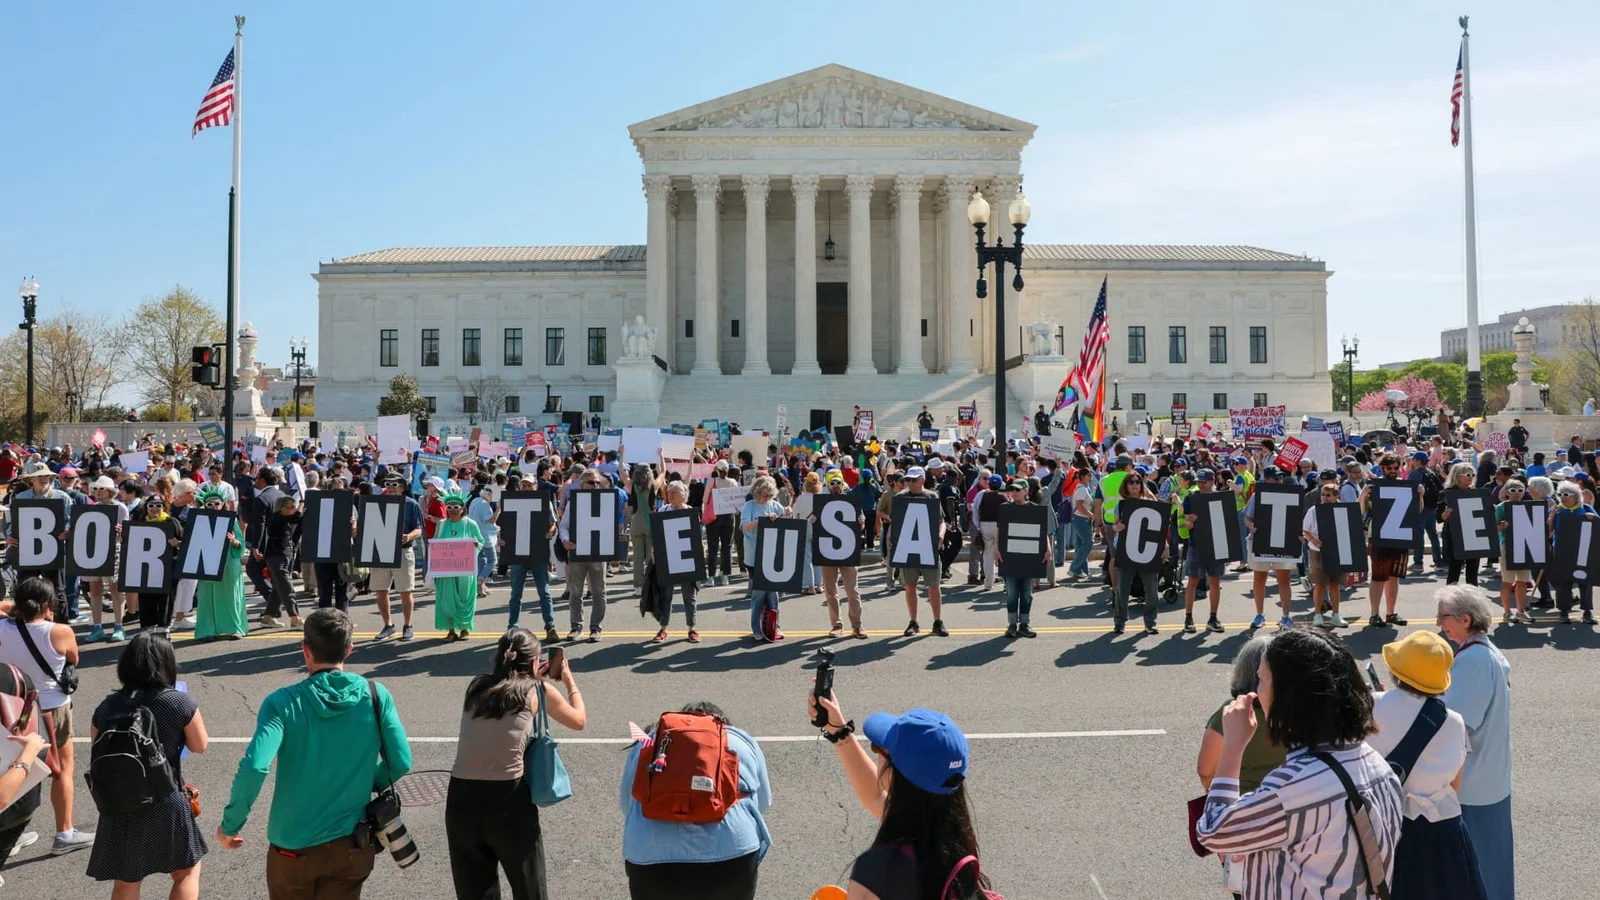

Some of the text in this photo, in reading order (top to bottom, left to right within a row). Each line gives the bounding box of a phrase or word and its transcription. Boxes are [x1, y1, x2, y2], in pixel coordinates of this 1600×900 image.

[1488, 432, 1506, 441] STOP
[1285, 443, 1303, 456] BIRTH
[1281, 450, 1300, 462] RIGHT
[18, 506, 231, 588] BORN
[316, 497, 400, 564] IN
[503, 492, 696, 574] THE
[762, 500, 936, 583] USA
[1126, 486, 1592, 580] CITIZEN!
[431, 558, 469, 568] BIRTHRIGHT
[949, 760, 962, 769] ACLU
